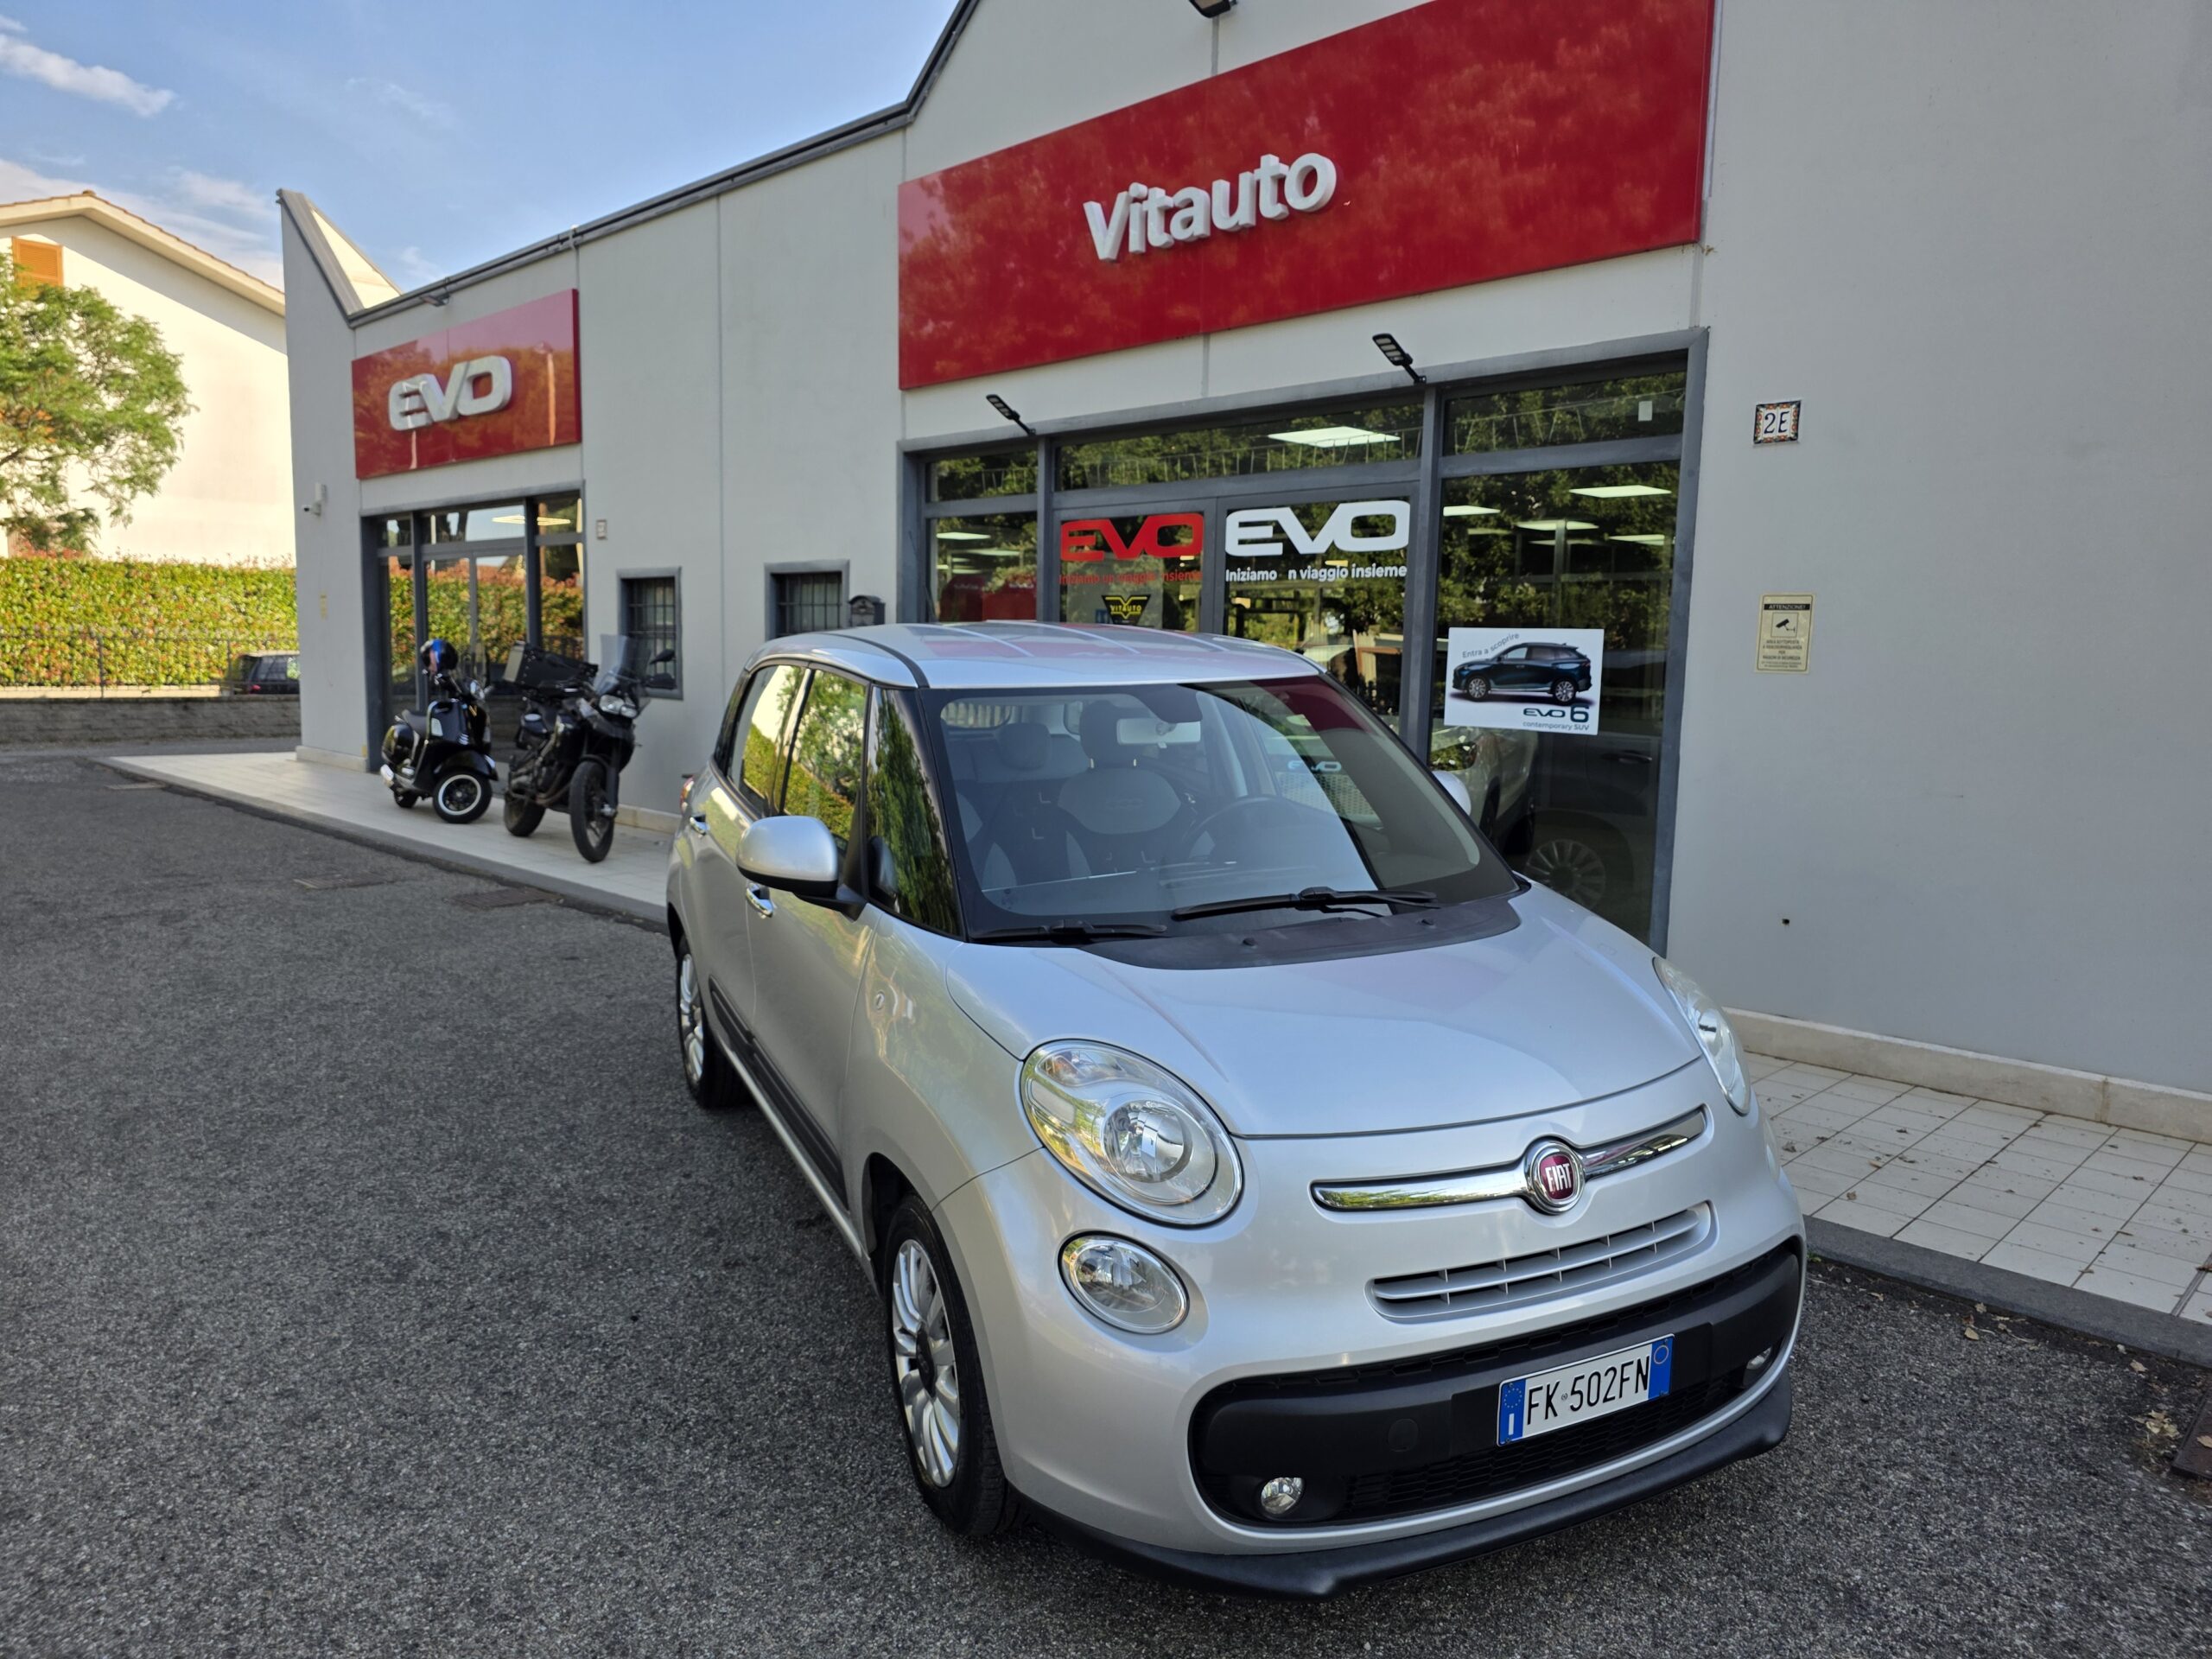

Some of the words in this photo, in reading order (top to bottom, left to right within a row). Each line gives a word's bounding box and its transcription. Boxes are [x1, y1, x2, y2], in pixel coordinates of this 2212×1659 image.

[1083, 153, 1337, 260] Vitauto
[389, 355, 512, 431] EVO
[1764, 410, 1790, 435] 2E
[1060, 512, 1205, 562] EVO
[1225, 499, 1411, 556] EVO
[1225, 567, 1277, 582] Iniziamo
[1300, 565, 1349, 582] viaggio
[1351, 563, 1408, 578] insieme
[1462, 649, 1483, 659] Entra
[1490, 632, 1520, 652] scoprire
[1522, 708, 1566, 718] EVO
[1570, 704, 1590, 723] 6
[1522, 721, 1573, 731] contemporary
[1287, 760, 1342, 772] EO
[1545, 1163, 1572, 1192] FIAT
